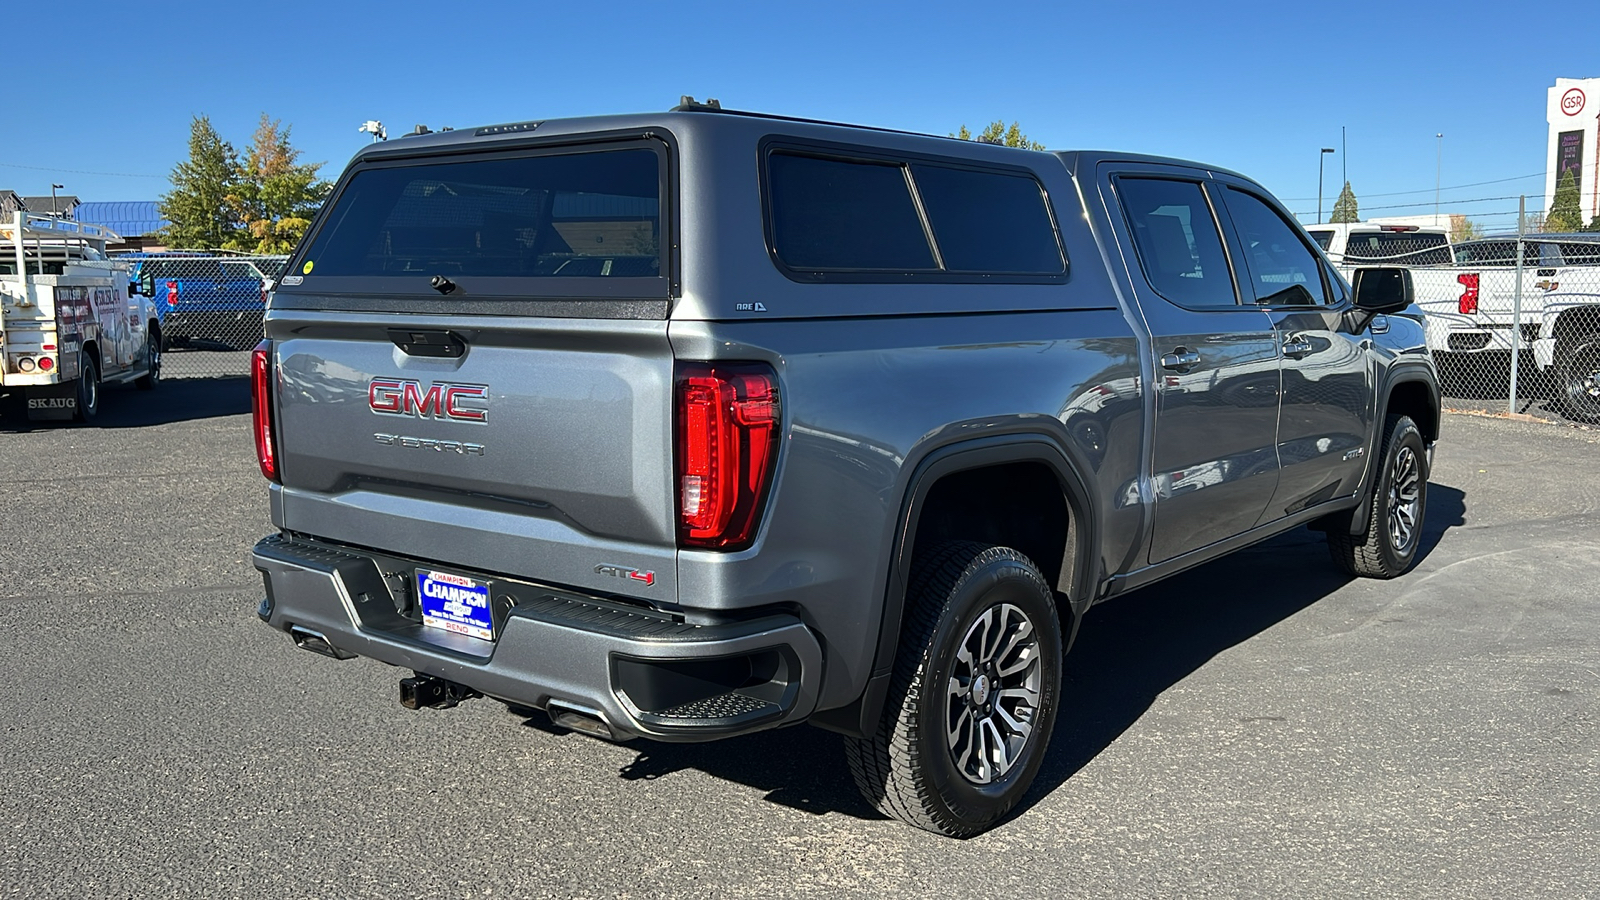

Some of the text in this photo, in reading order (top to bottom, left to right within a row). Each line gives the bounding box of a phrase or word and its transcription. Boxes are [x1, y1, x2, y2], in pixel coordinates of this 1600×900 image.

[1564, 96, 1582, 108] GSR
[28, 398, 76, 409] SKAUG
[368, 377, 489, 425] GMC
[373, 432, 485, 457] SIERRA
[434, 573, 469, 586] CHAMPION
[594, 562, 656, 588] AT4
[424, 578, 487, 609] CHAMPION
[446, 622, 469, 634] RENO
